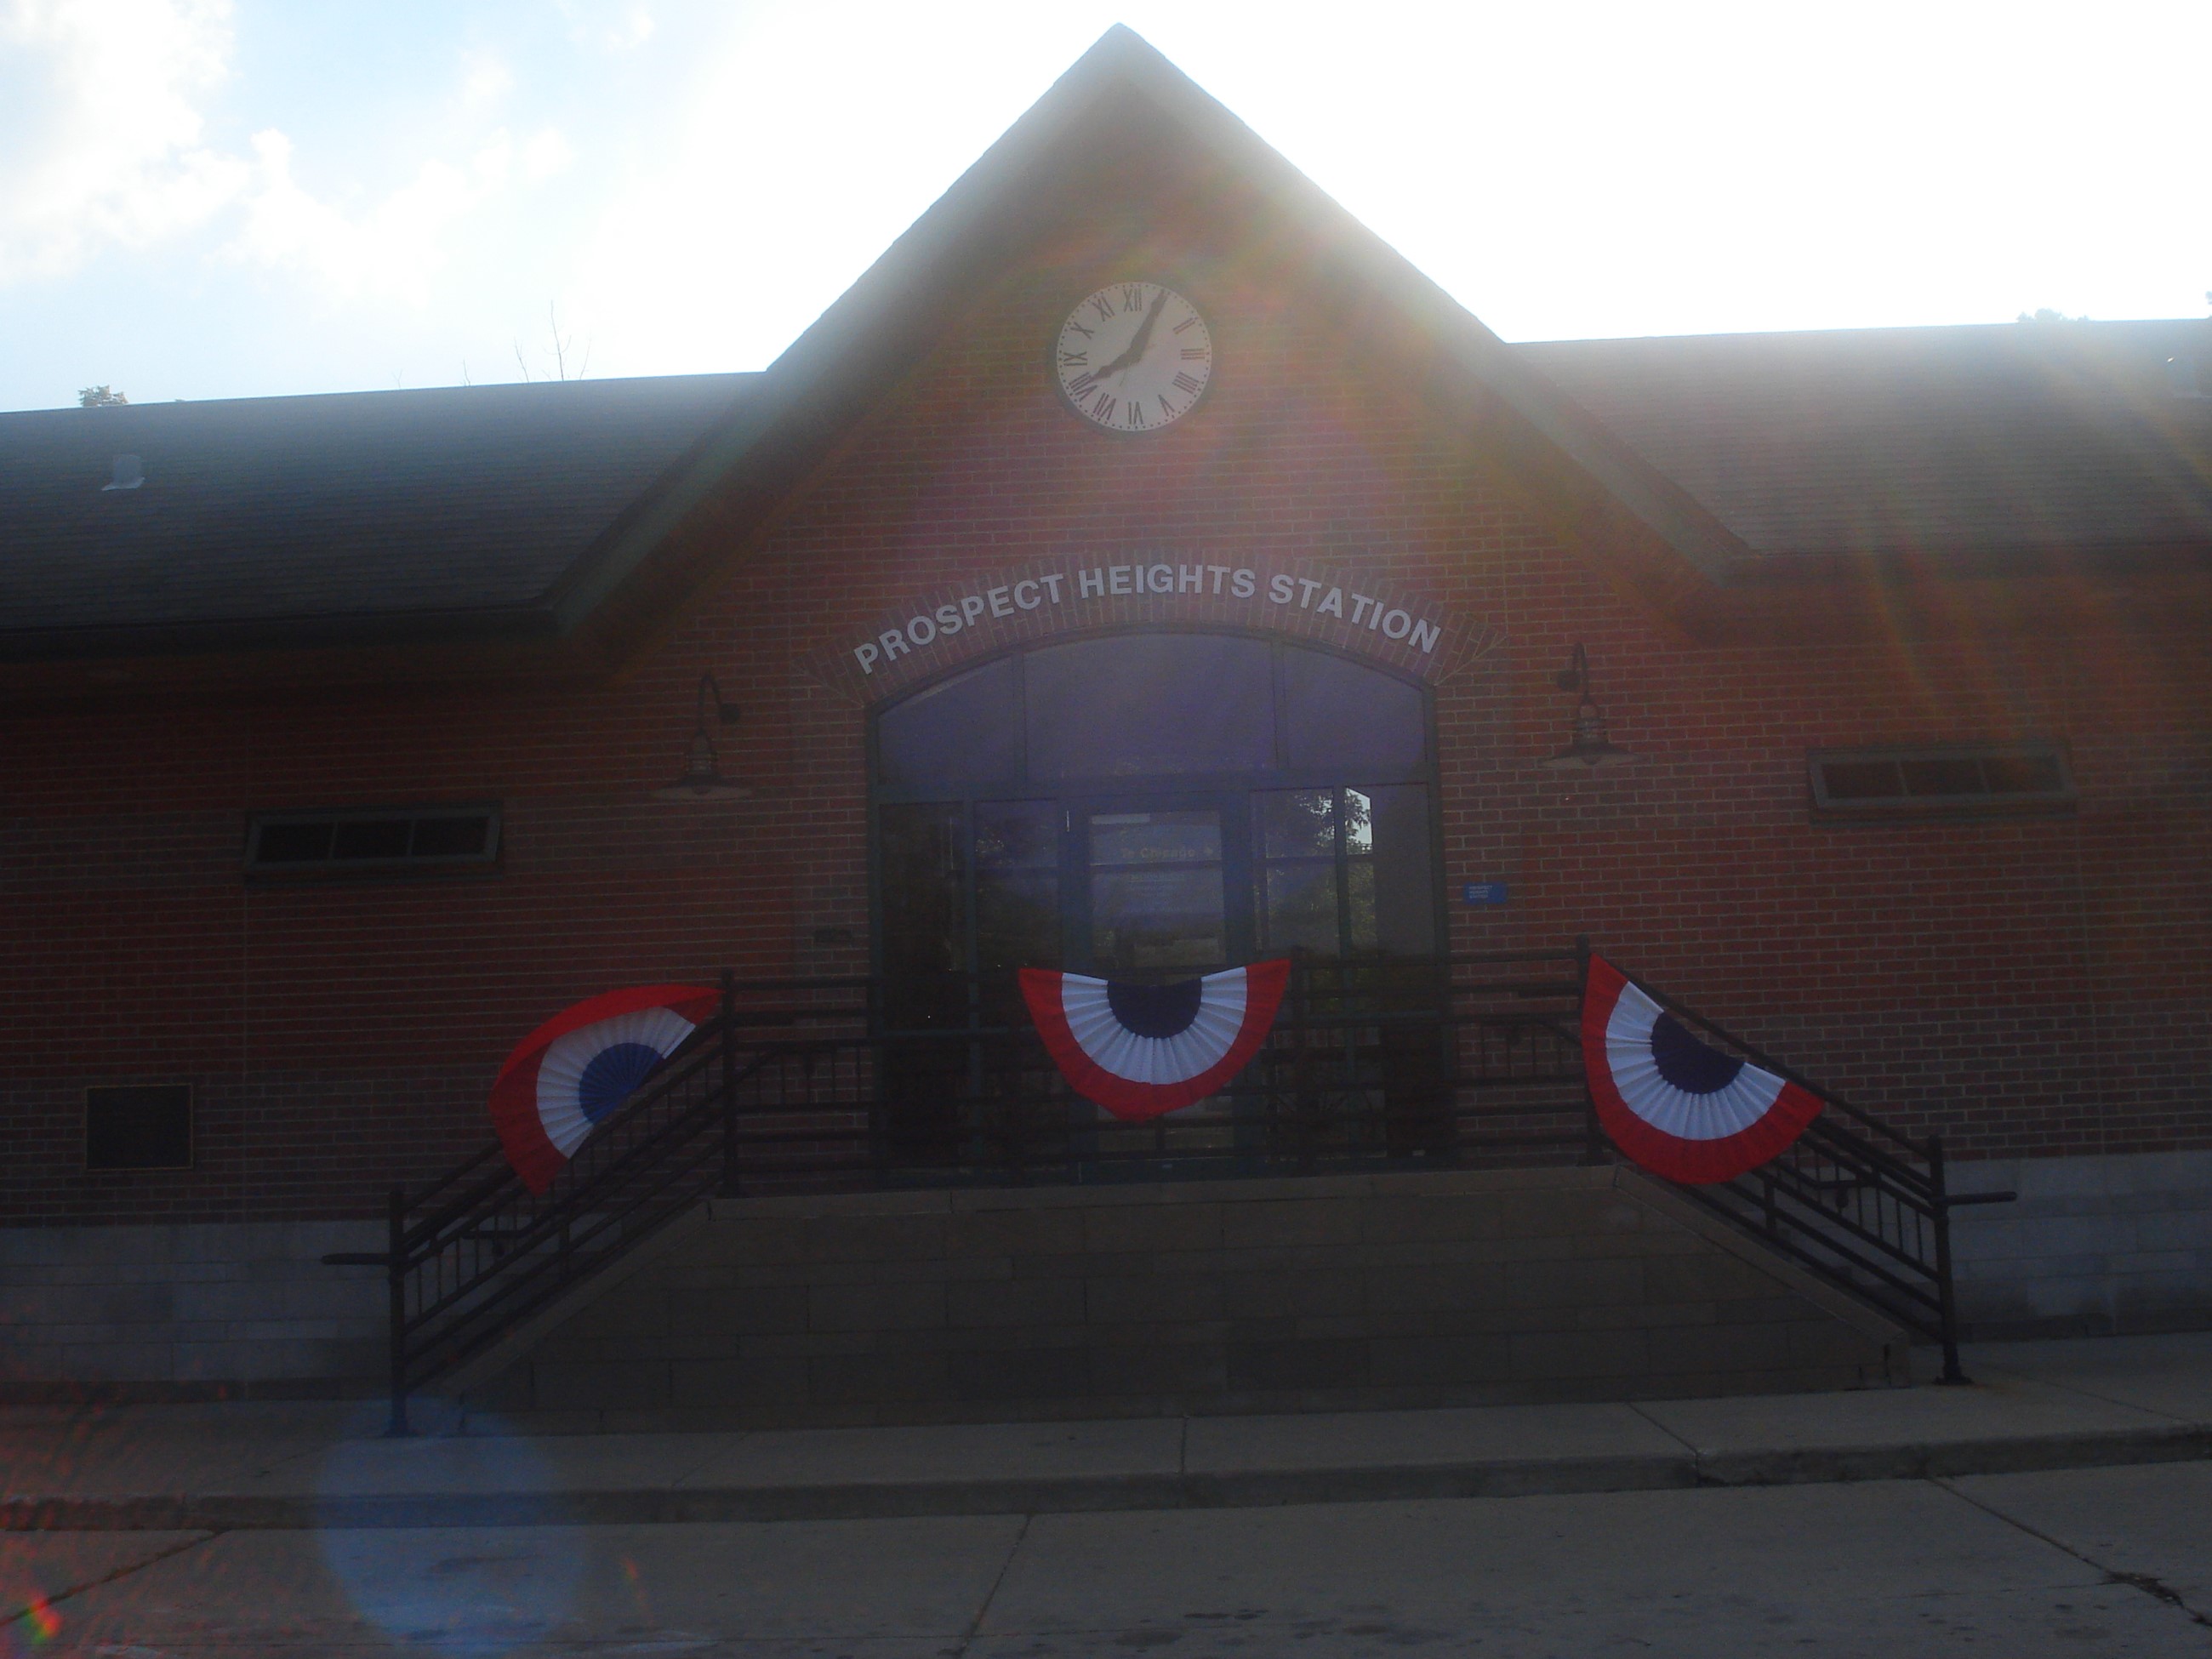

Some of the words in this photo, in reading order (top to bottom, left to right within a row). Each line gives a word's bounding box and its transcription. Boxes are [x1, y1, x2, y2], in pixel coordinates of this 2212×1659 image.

[1091, 294, 1115, 322] XI
[1123, 288, 1143, 312] XII
[1070, 322, 1094, 340] X
[1063, 351, 1088, 366] IX
[1181, 348, 1206, 360] III
[1092, 392, 1117, 420] VII
[1127, 401, 1143, 425] VI
[1158, 394, 1175, 417] V
[854, 573, 1063, 675] PROSPECT
[1079, 563, 1256, 599] HEIGHTS
[1268, 574, 1441, 654] STATION
